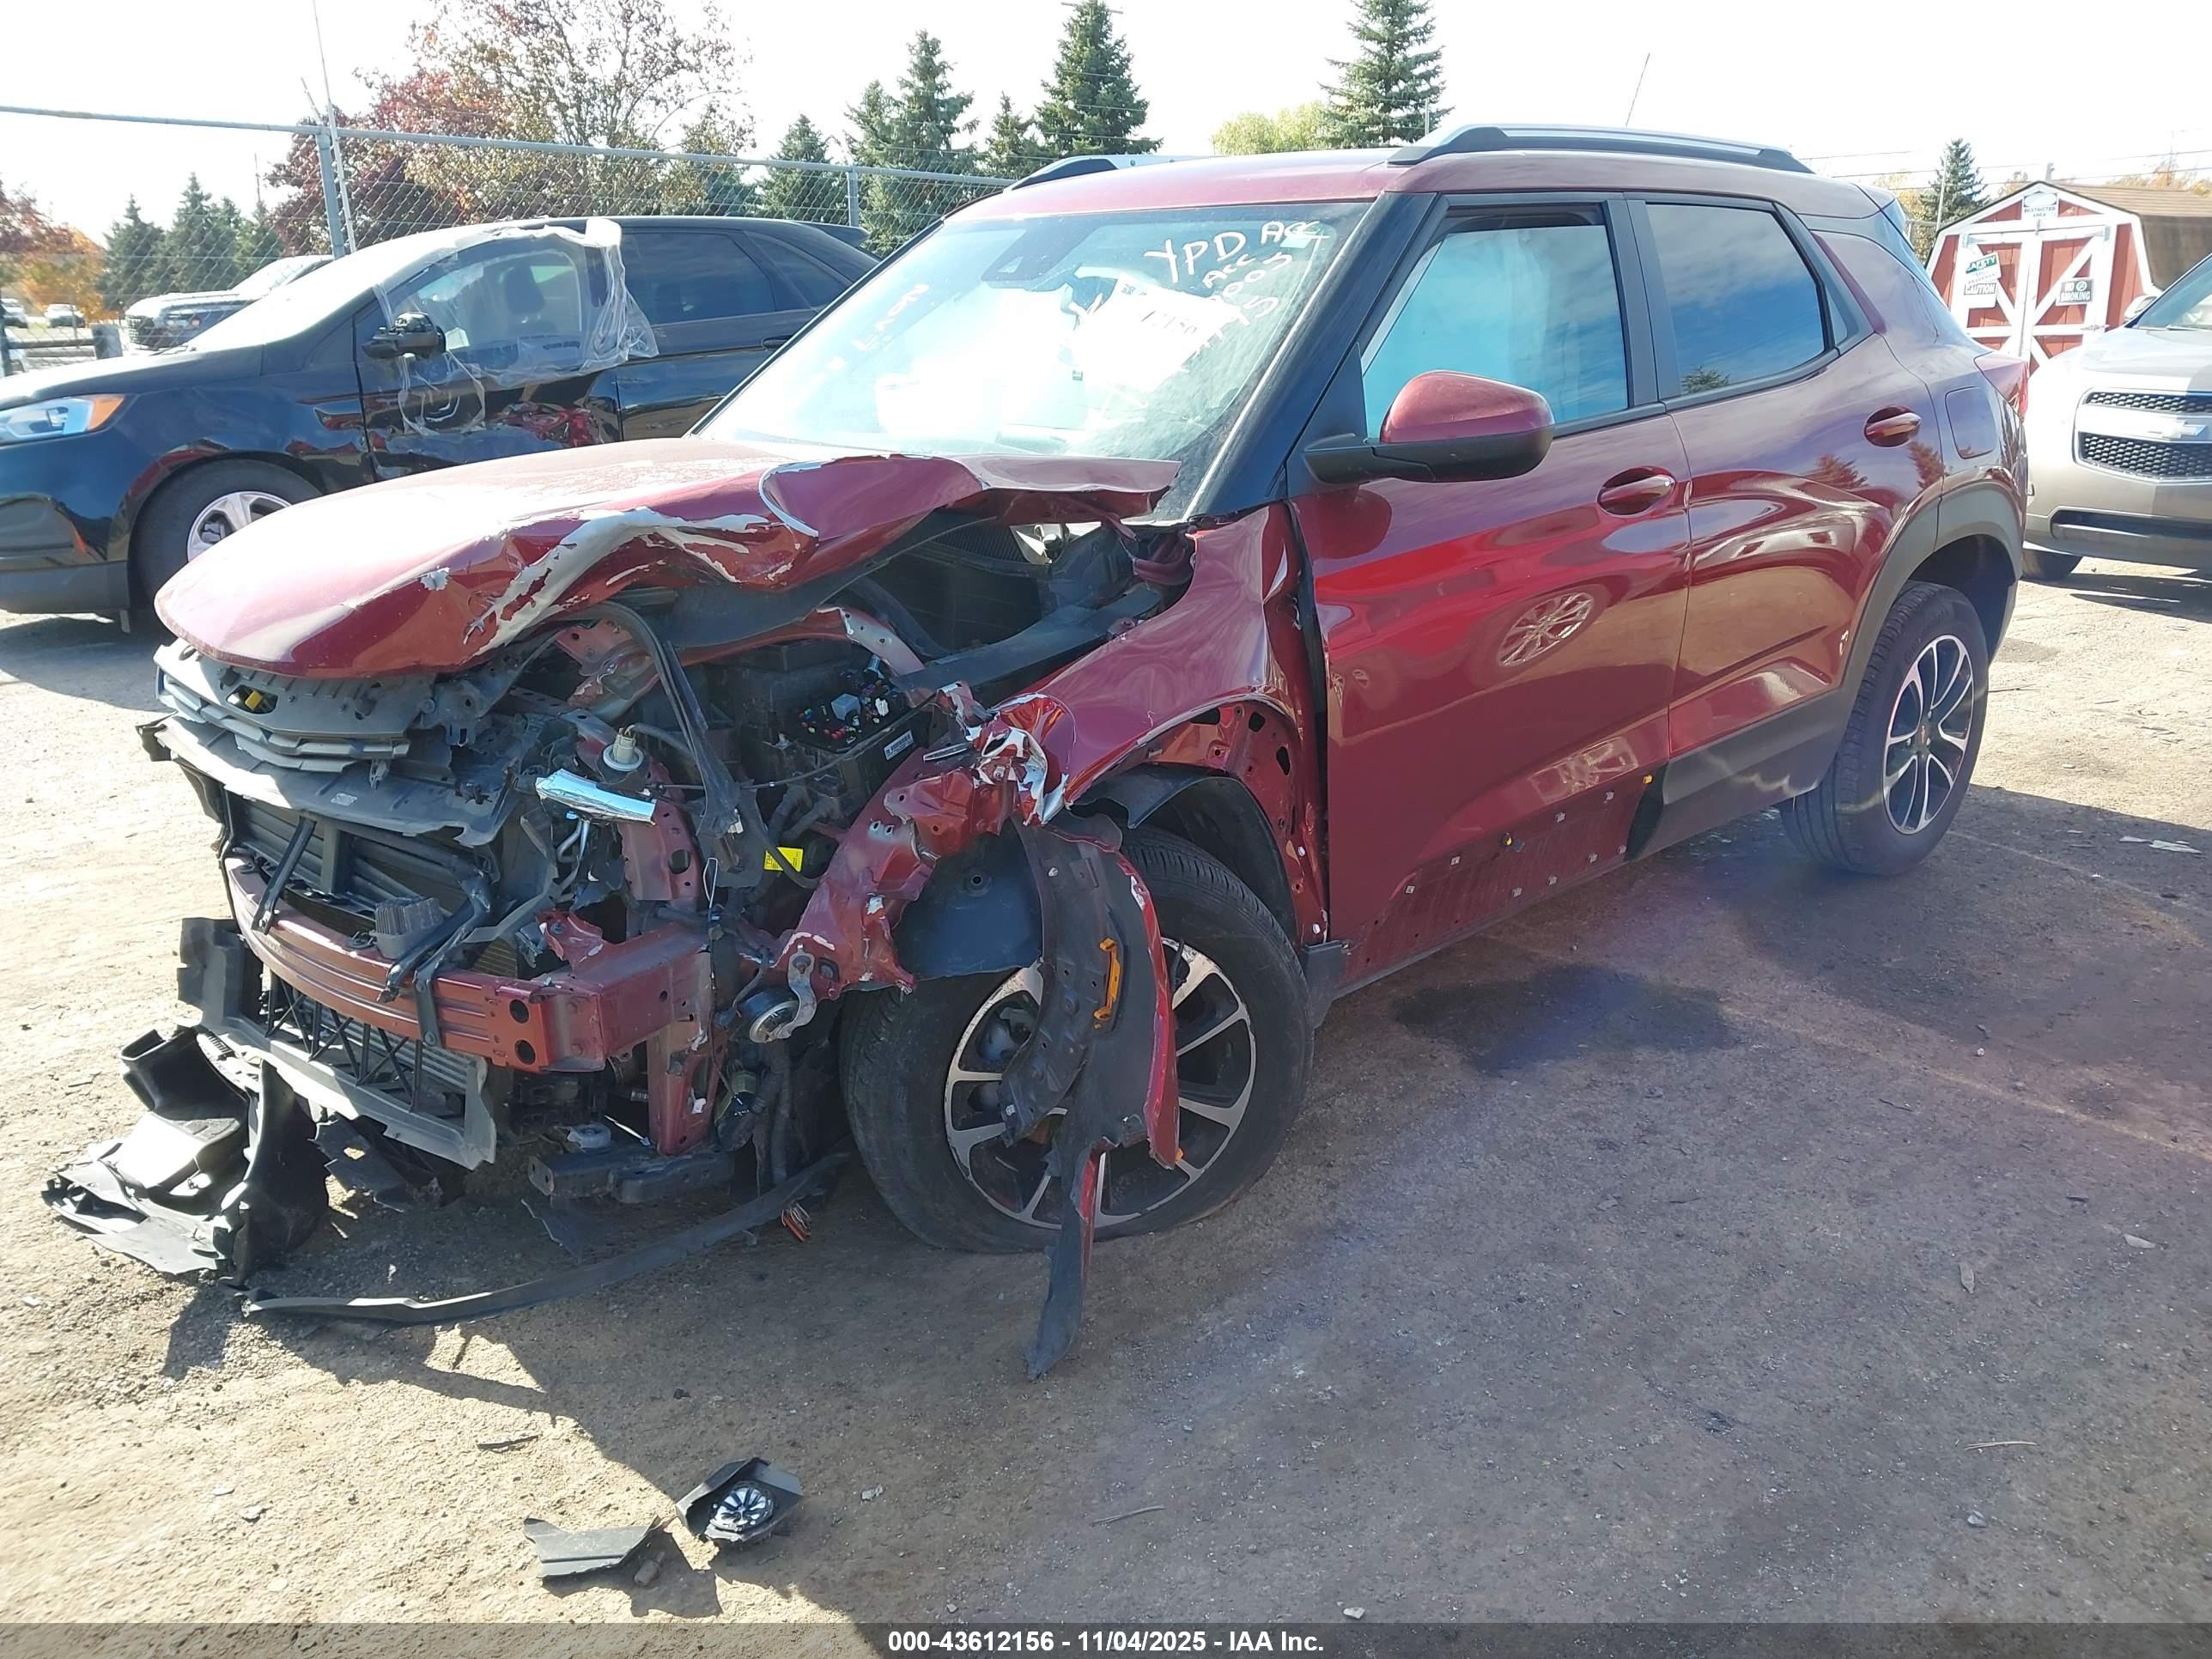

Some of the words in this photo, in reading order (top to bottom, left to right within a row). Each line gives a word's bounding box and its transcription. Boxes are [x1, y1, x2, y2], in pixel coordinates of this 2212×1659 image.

[1966, 256, 1996, 272] SAFETY
[1965, 283, 1995, 295] CAUTION
[2064, 282, 2075, 291] NO
[2060, 291, 2090, 301] SMOKING
